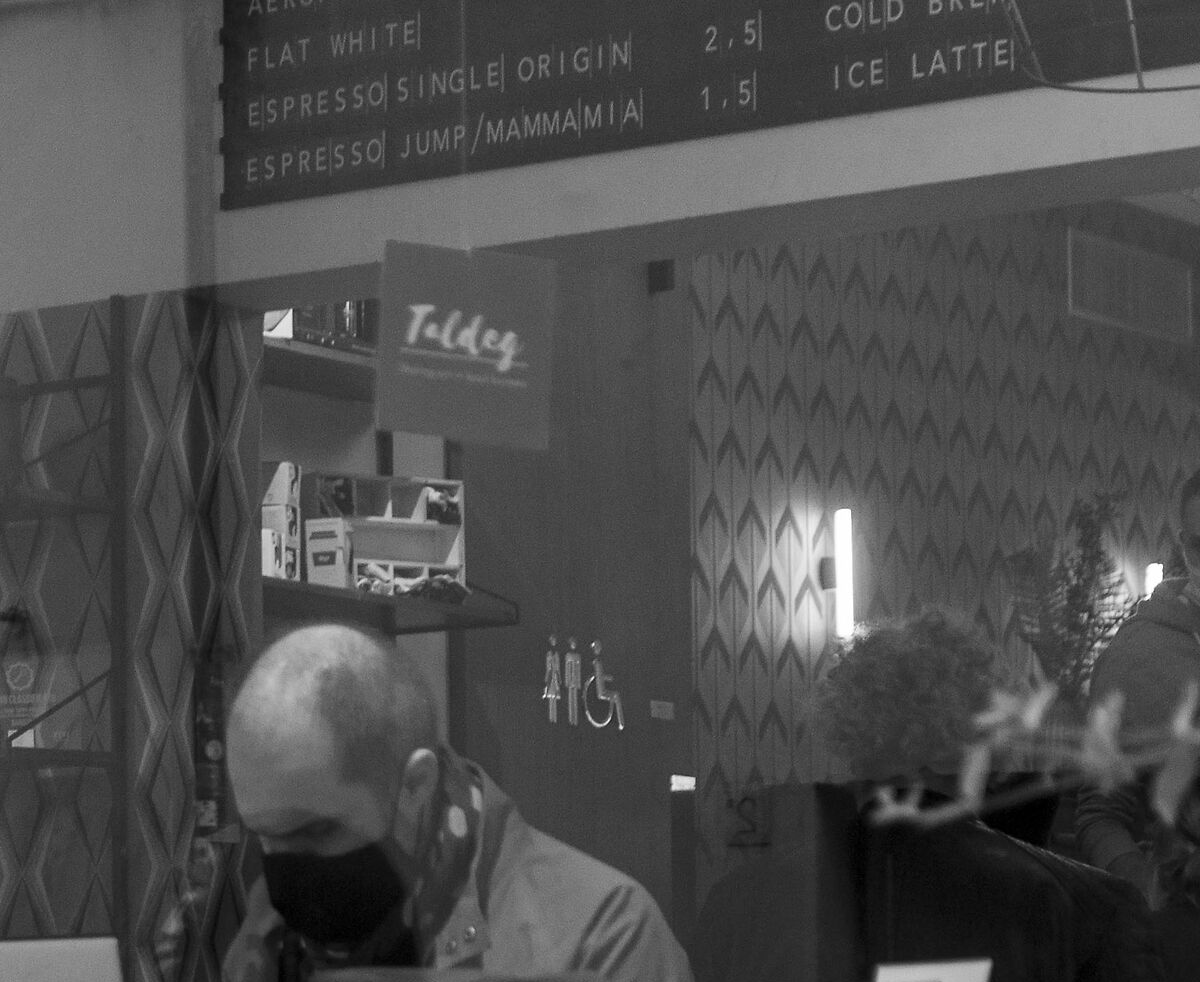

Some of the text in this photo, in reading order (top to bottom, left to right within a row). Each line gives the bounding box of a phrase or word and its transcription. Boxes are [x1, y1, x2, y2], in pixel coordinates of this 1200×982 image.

[825, 0, 904, 31] COLD
[248, 19, 415, 71] FLAT WHITE
[834, 39, 1009, 90] ICE LATTE
[249, 81, 384, 126] ESPRESSO
[397, 62, 499, 102] SINGLE
[517, 40, 629, 82] ORIGIN
[247, 138, 382, 182] ESPRESSO
